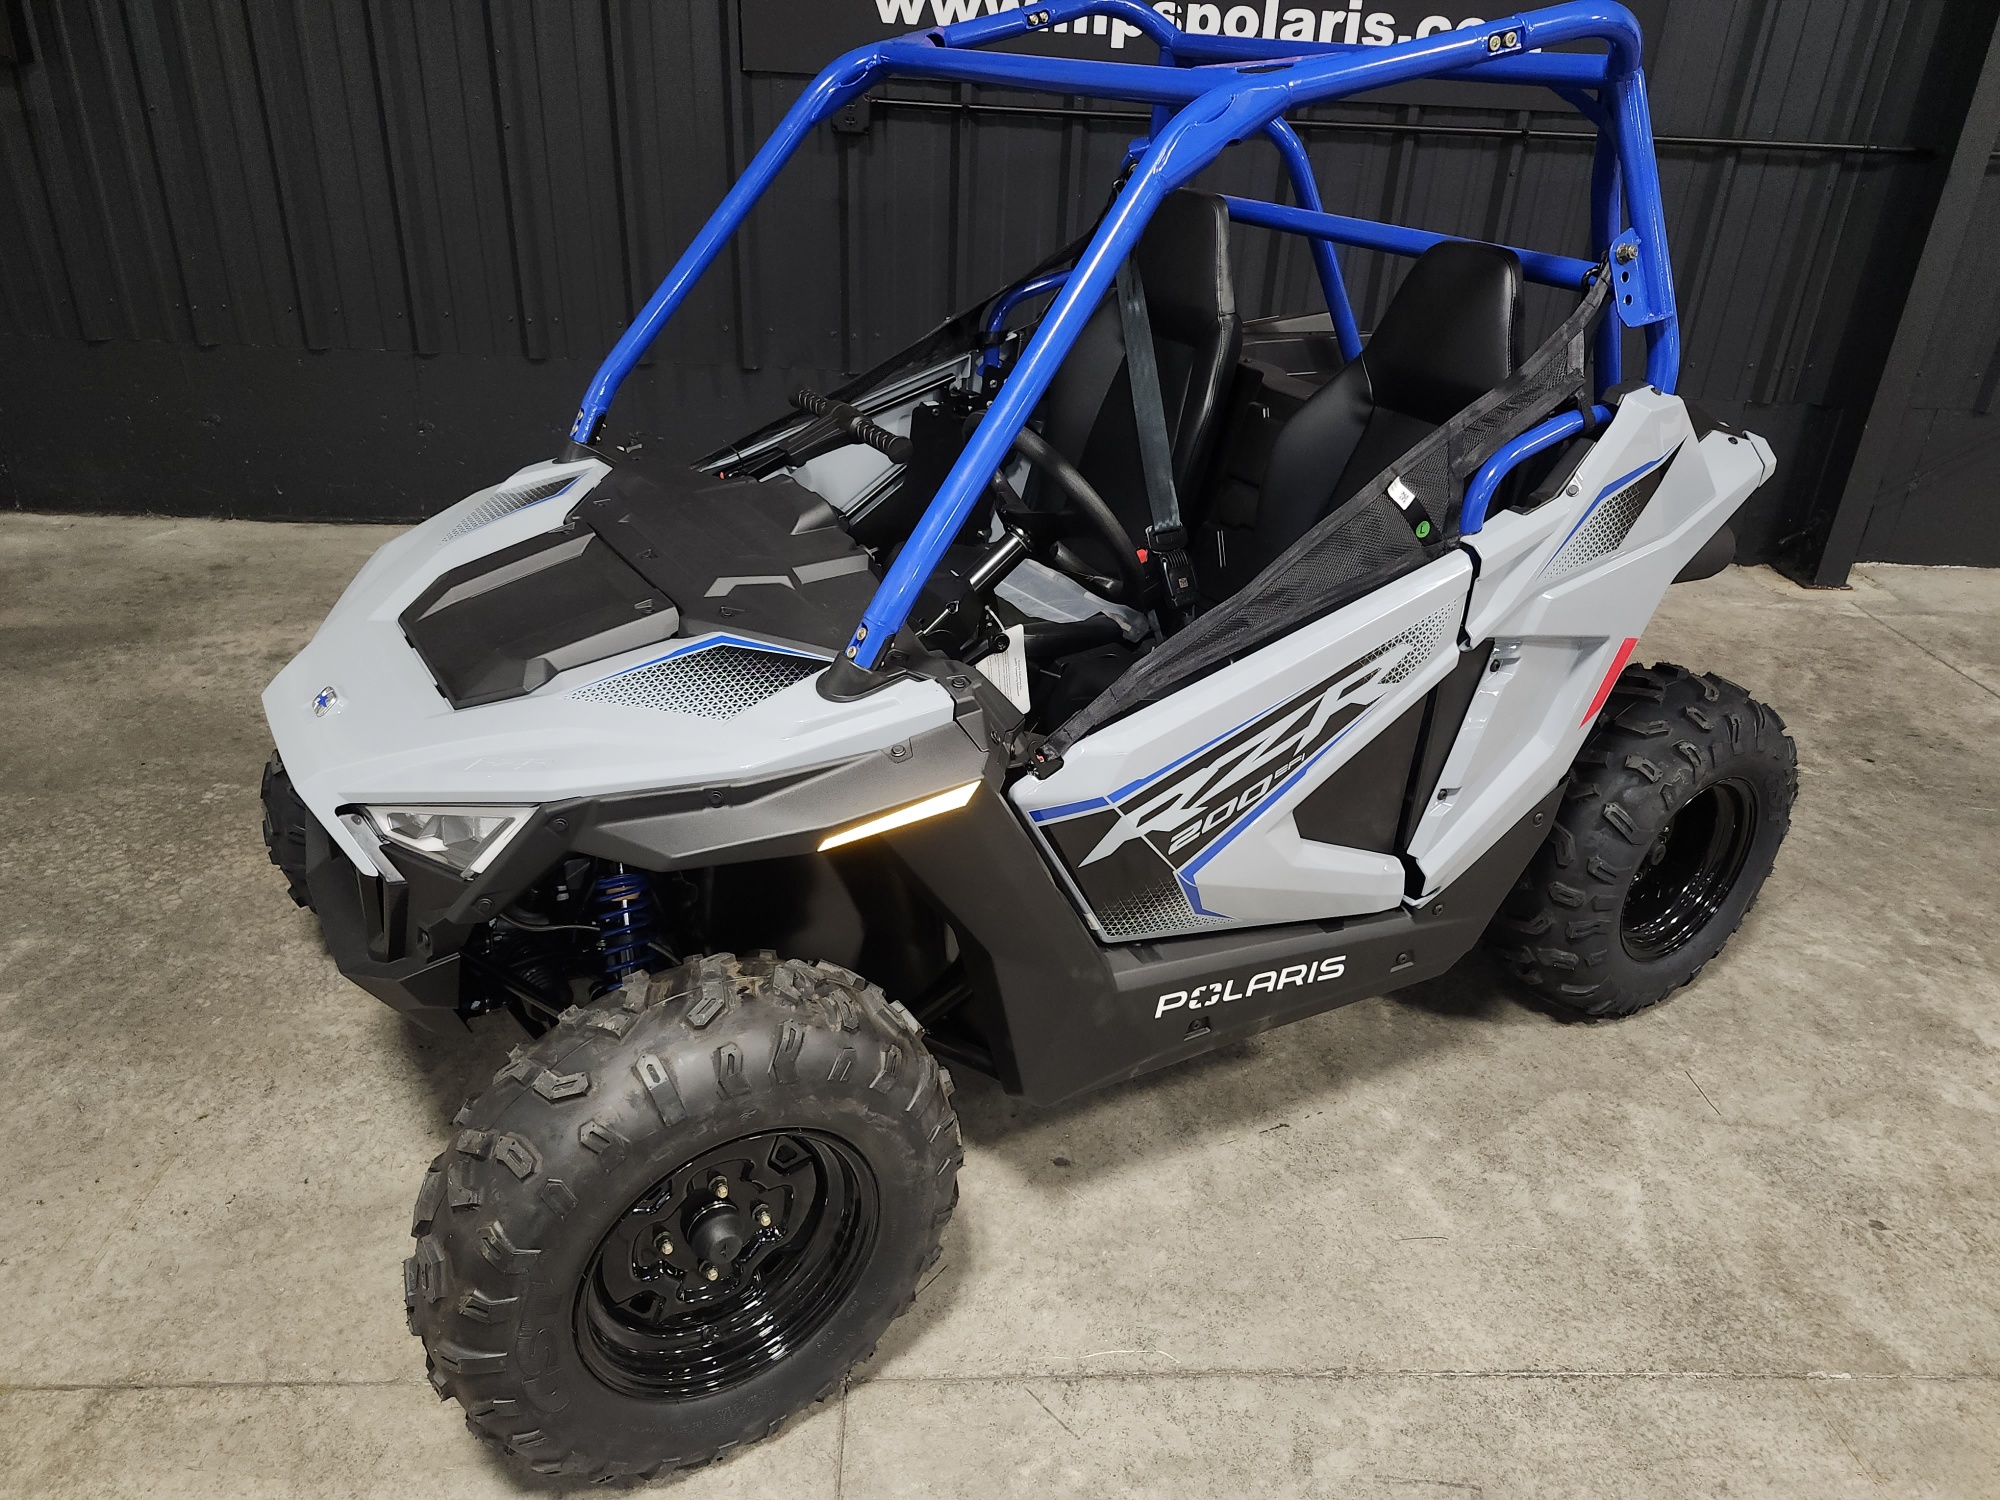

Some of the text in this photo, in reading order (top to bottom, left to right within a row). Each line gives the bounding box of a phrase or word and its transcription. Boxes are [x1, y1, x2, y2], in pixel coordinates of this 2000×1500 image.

[1419, 525, 1426, 535] L
[1078, 643, 1416, 868] RZR
[1154, 955, 1347, 1019] POLARIS
[515, 1282, 571, 1412] CST
